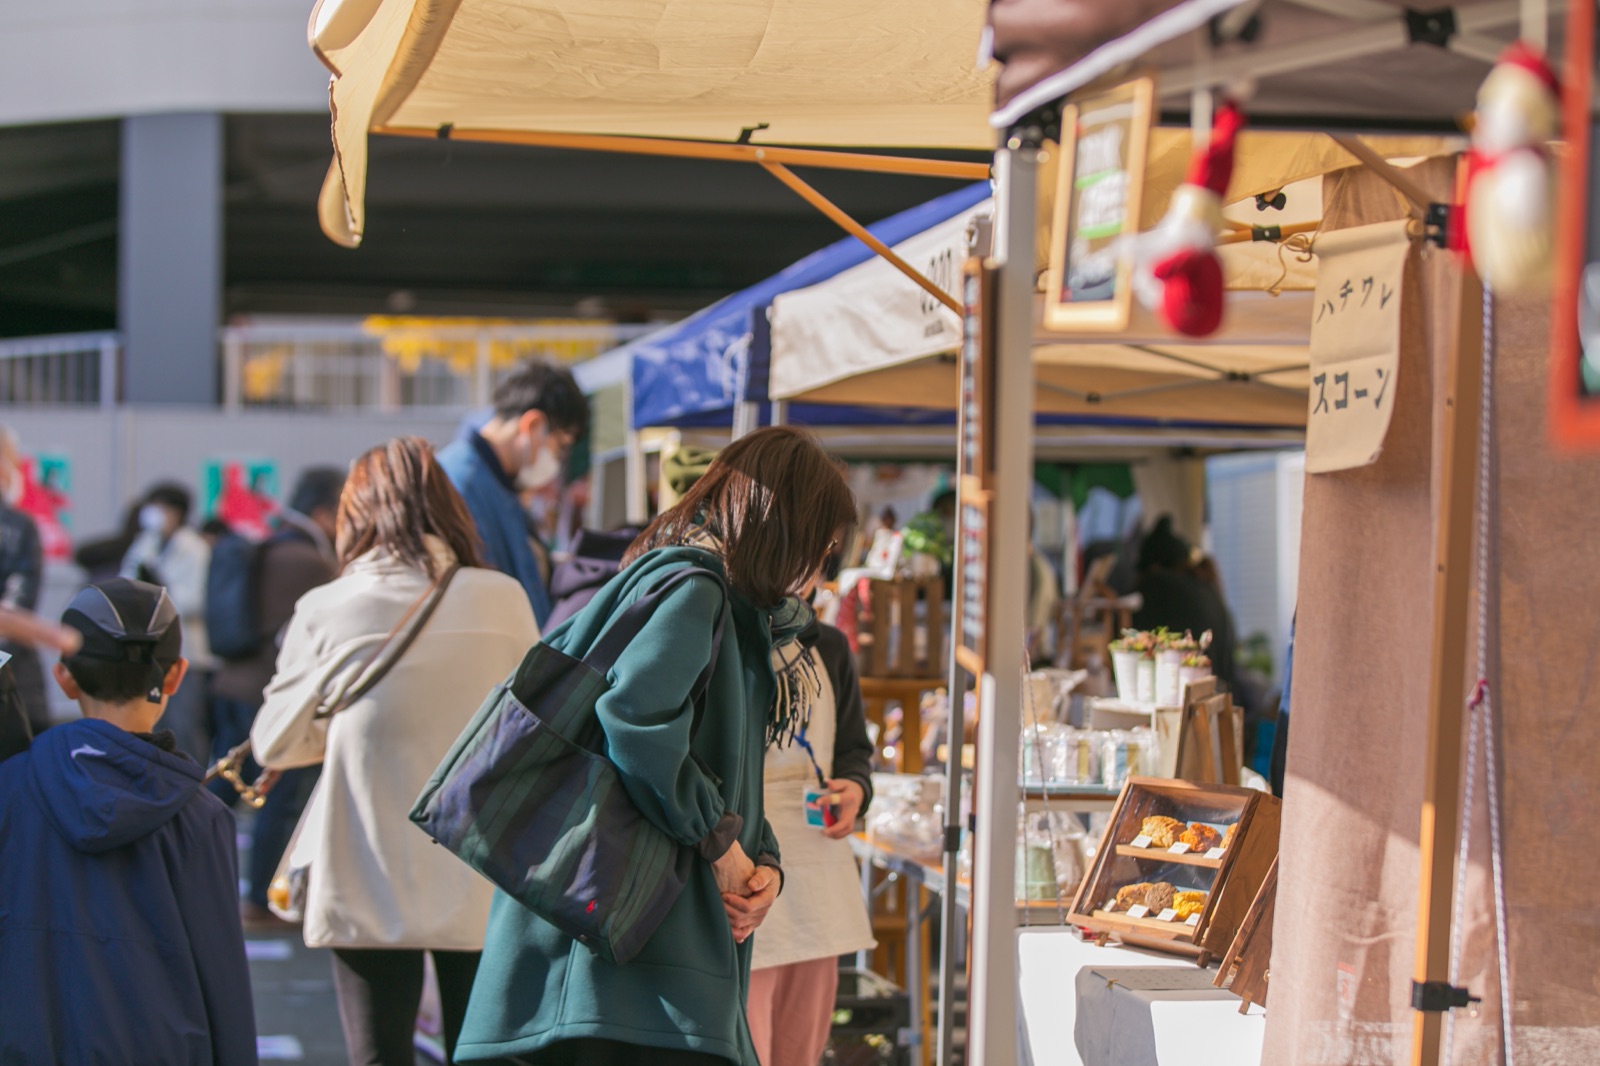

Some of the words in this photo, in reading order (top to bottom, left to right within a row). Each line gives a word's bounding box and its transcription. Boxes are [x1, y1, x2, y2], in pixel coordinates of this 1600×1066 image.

[1316, 275, 1394, 324] ハチワレ
[1312, 368, 1391, 415] スコーン
